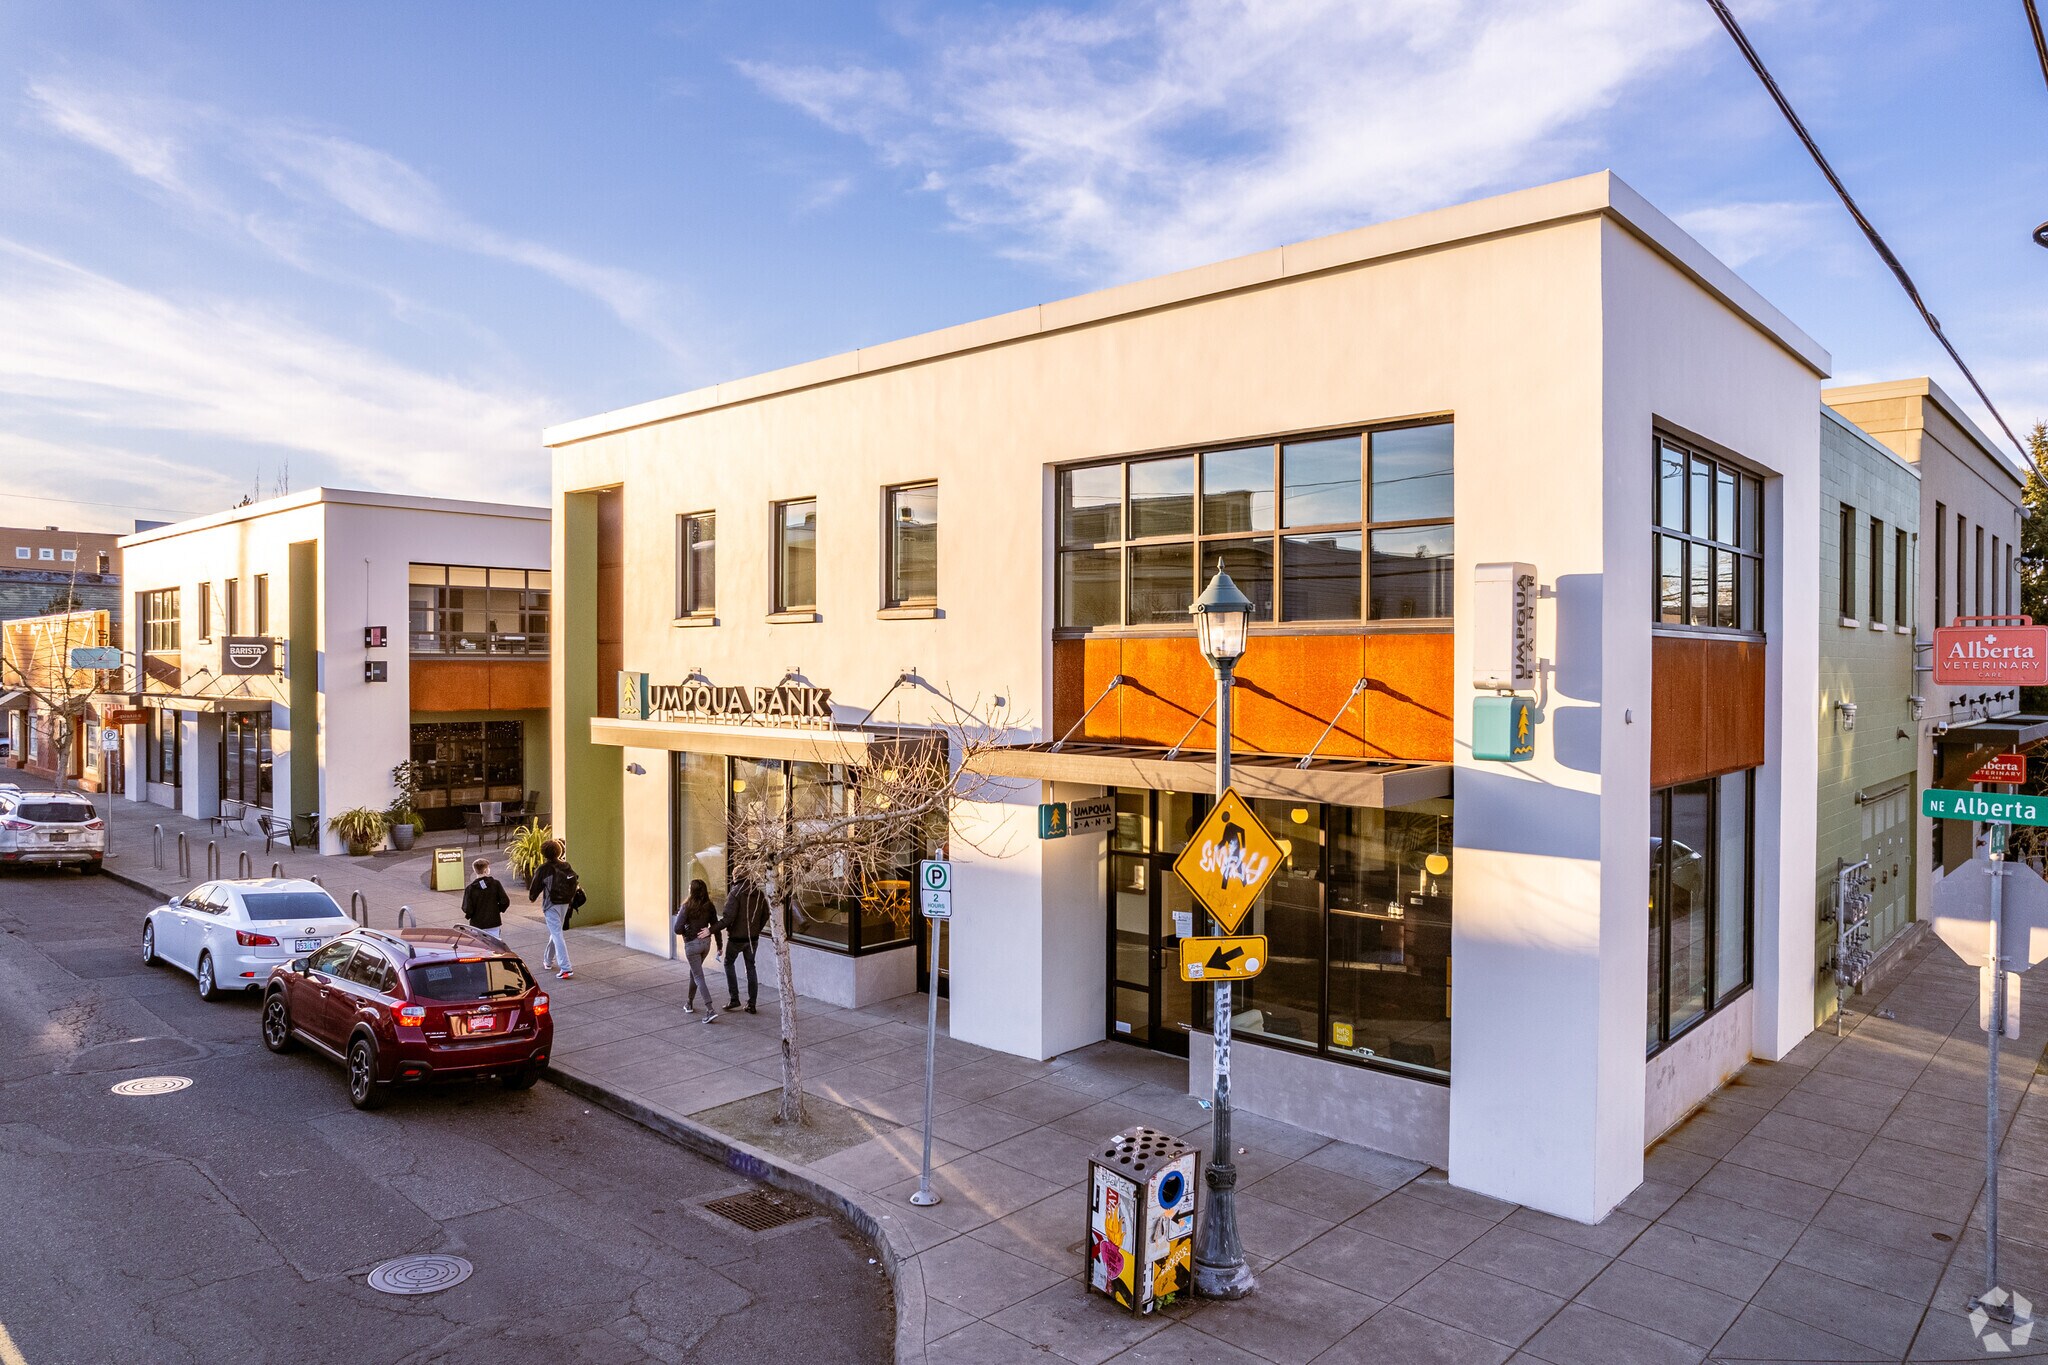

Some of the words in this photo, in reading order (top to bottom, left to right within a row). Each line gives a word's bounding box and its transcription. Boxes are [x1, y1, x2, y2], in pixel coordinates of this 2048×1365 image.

[1515, 575, 1526, 679] UMPQUA
[1948, 641, 2035, 658] Alberta
[1943, 661, 2040, 669] VETERINARY
[648, 685, 747, 715] UMPQUA
[753, 686, 828, 716] BANK
[1074, 803, 1112, 817] UMPQUA
[1930, 800, 1945, 812] NE
[1954, 797, 2036, 820] Alberta
[932, 869, 942, 884] P
[933, 893, 939, 902] 2
[1336, 1034, 1350, 1043] talk
